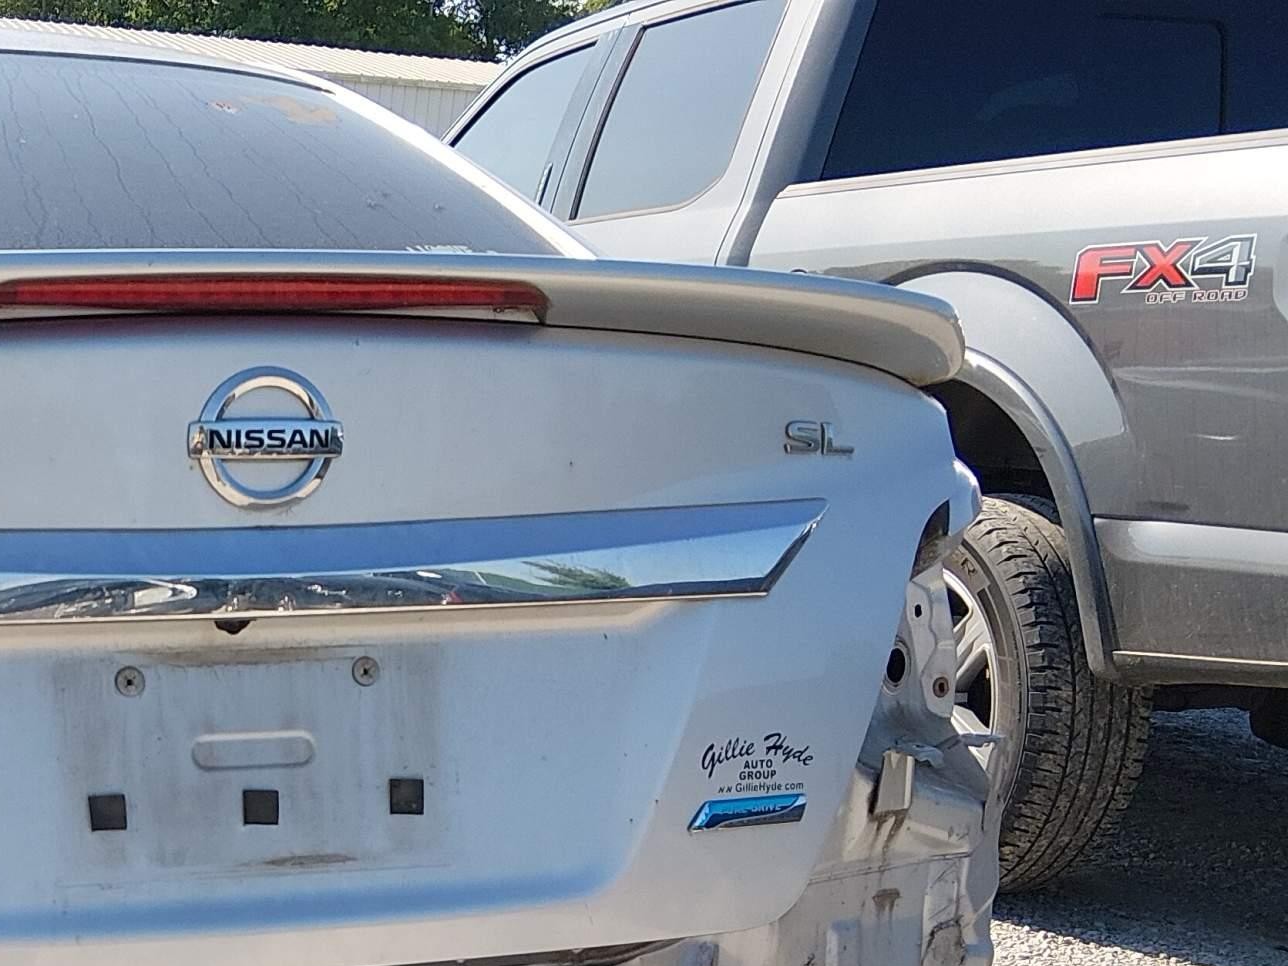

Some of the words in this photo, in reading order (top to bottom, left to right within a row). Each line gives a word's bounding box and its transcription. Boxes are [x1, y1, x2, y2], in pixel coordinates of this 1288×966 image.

[1069, 233, 1258, 304] FX4
[1145, 290, 1186, 304] OFF
[1192, 288, 1249, 303] ROAD
[208, 428, 330, 449] NISSAN
[784, 420, 855, 456] SL
[701, 737, 755, 779] Gillie
[763, 732, 814, 766] Hyde
[743, 759, 774, 770] AUTO
[738, 769, 777, 781] GROUP
